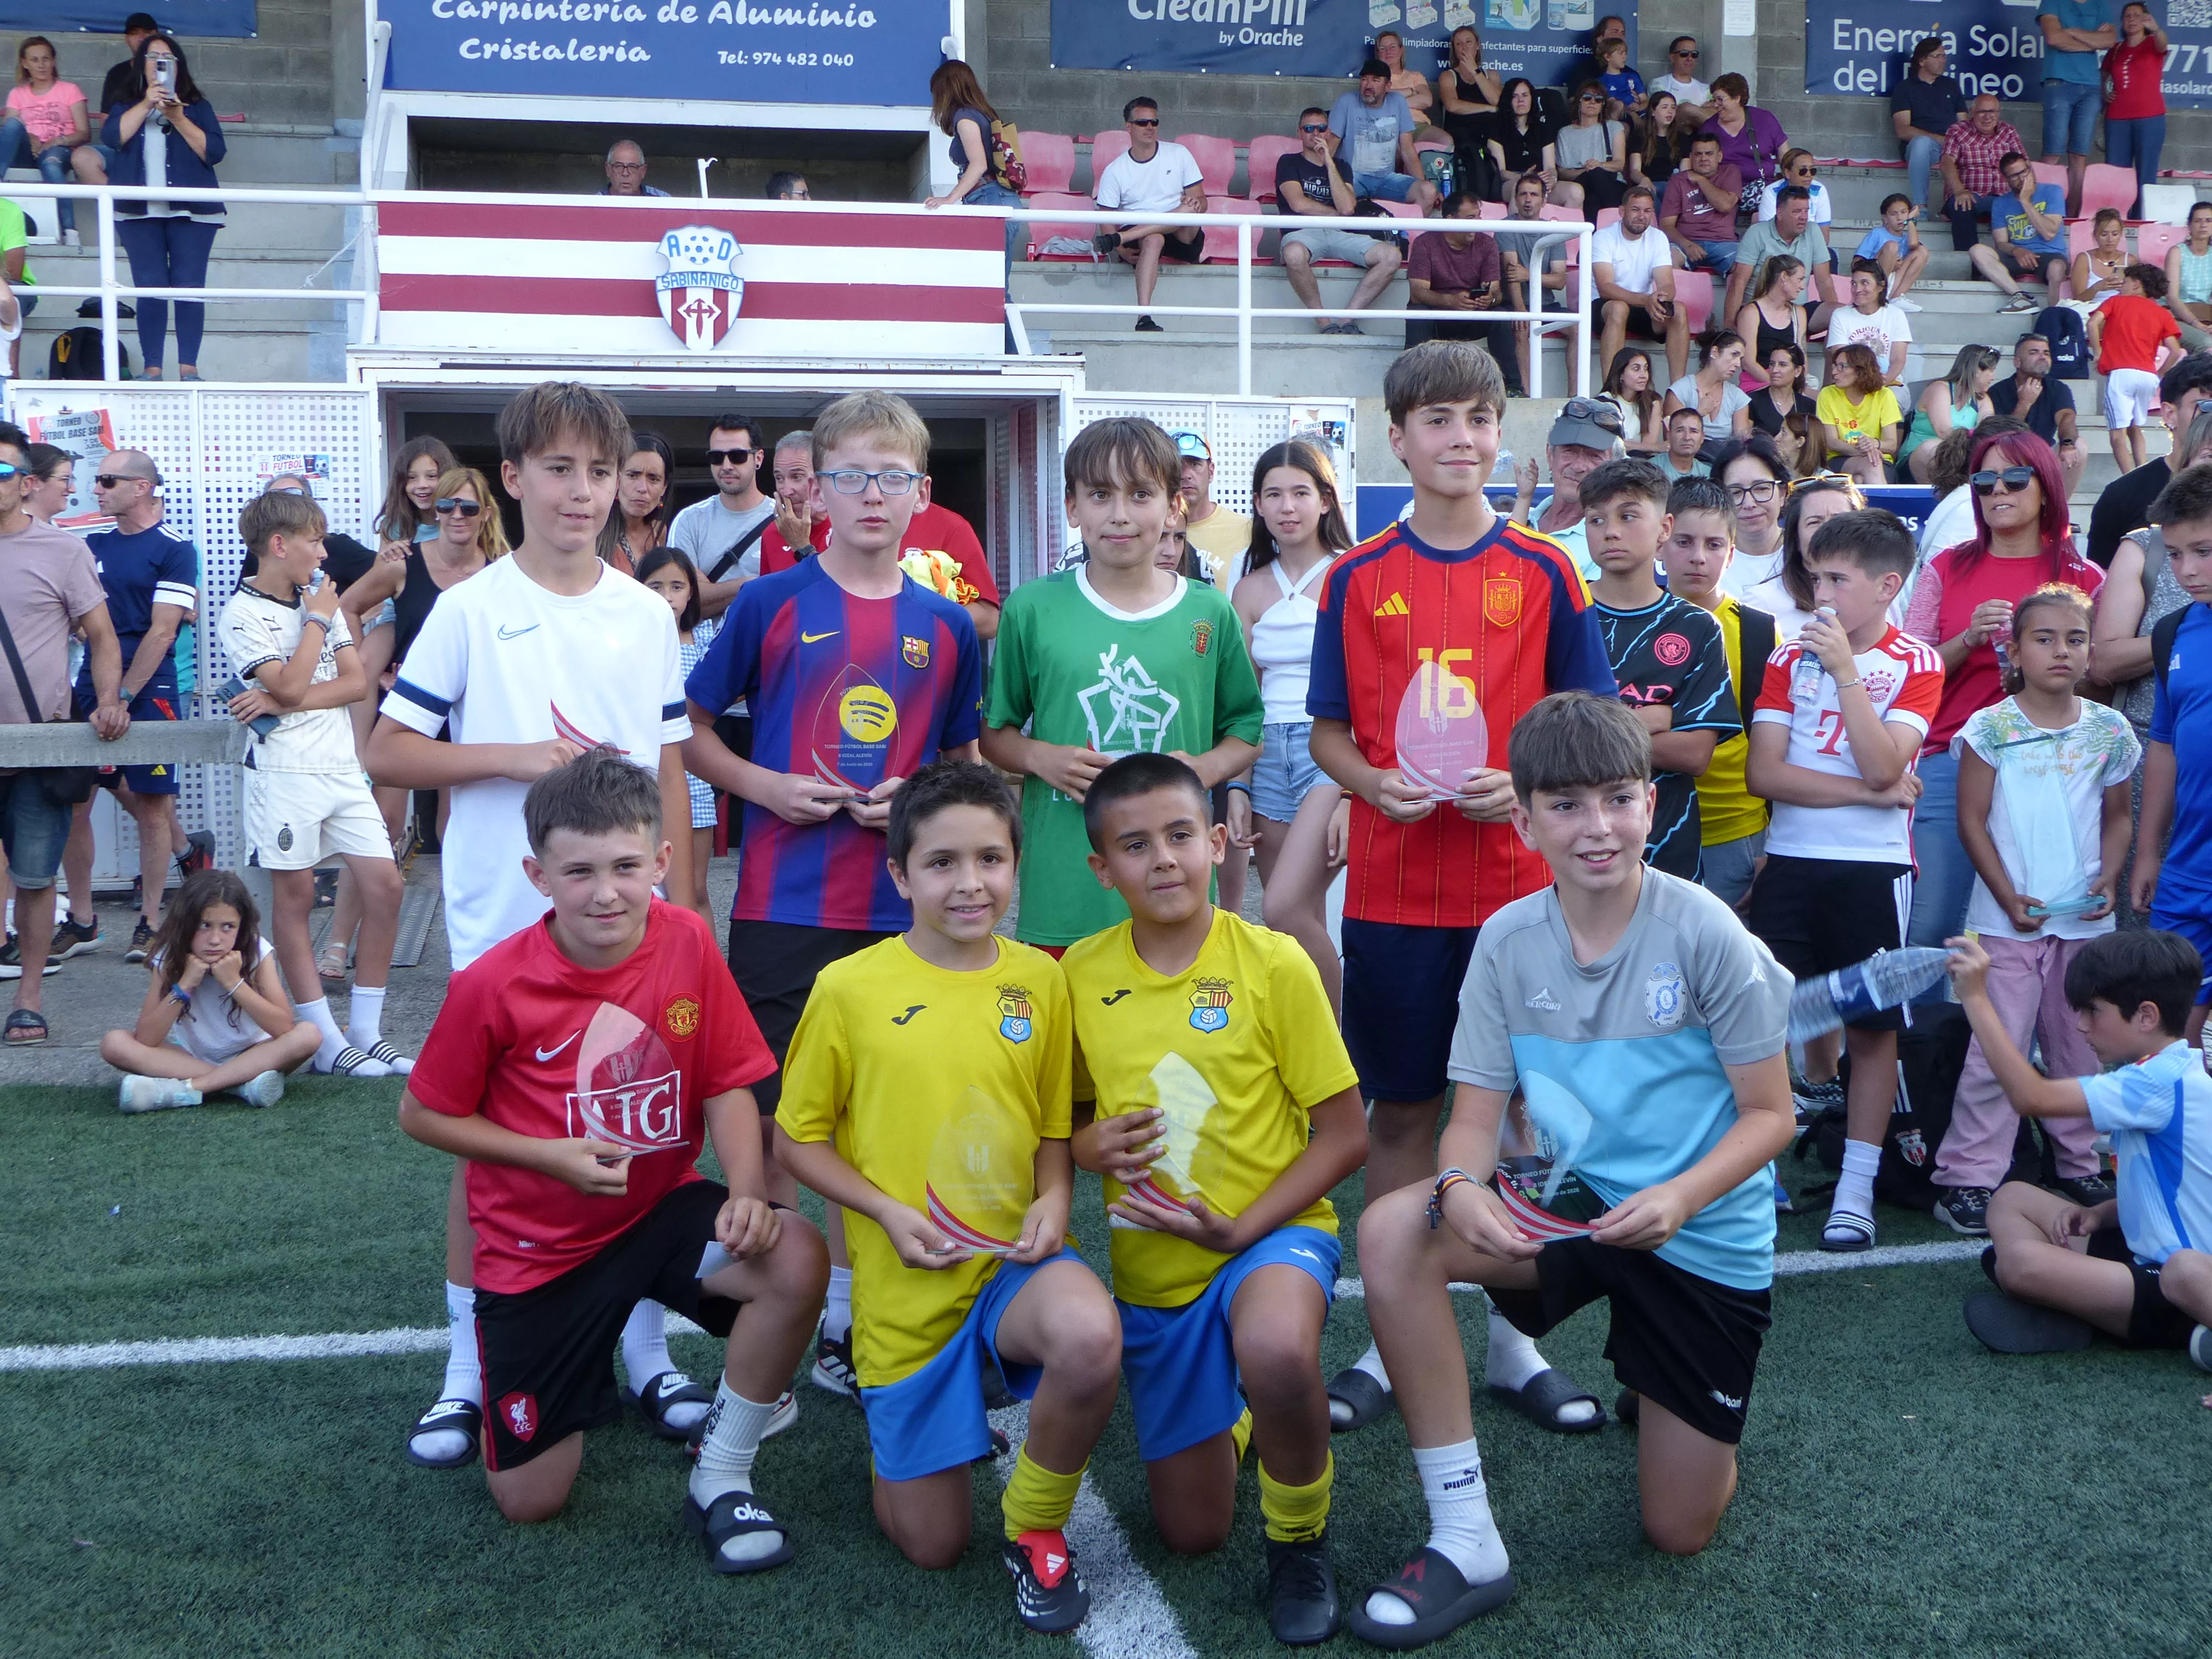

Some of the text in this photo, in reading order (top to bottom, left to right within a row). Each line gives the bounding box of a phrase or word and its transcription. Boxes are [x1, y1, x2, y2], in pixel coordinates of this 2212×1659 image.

[657, 0, 699, 23] de
[708, 0, 877, 28] Aluminio
[1219, 28, 1303, 46] by Orache
[1365, 36, 1376, 45] Pa
[1481, 41, 1525, 51] nfectantes
[1528, 44, 1546, 54] para
[1834, 18, 1957, 58] Energa
[459, 38, 651, 62] Cristaleria
[718, 51, 854, 66] Tel: 974 482 040
[1834, 60, 2024, 98] del ineo
[666, 234, 732, 261] A D
[57, 416, 82, 427] TORNEO
[68, 427, 86, 439] BASE
[1417, 648, 1476, 719] 16
[1513, 1171, 1538, 1181] TORNEO
[1539, 1166, 1561, 1176] FÚTBOL
[662, 1373, 690, 1388] NIKE
[427, 1401, 466, 1416] NIKE
[1443, 1475, 1475, 1491] PUMA
